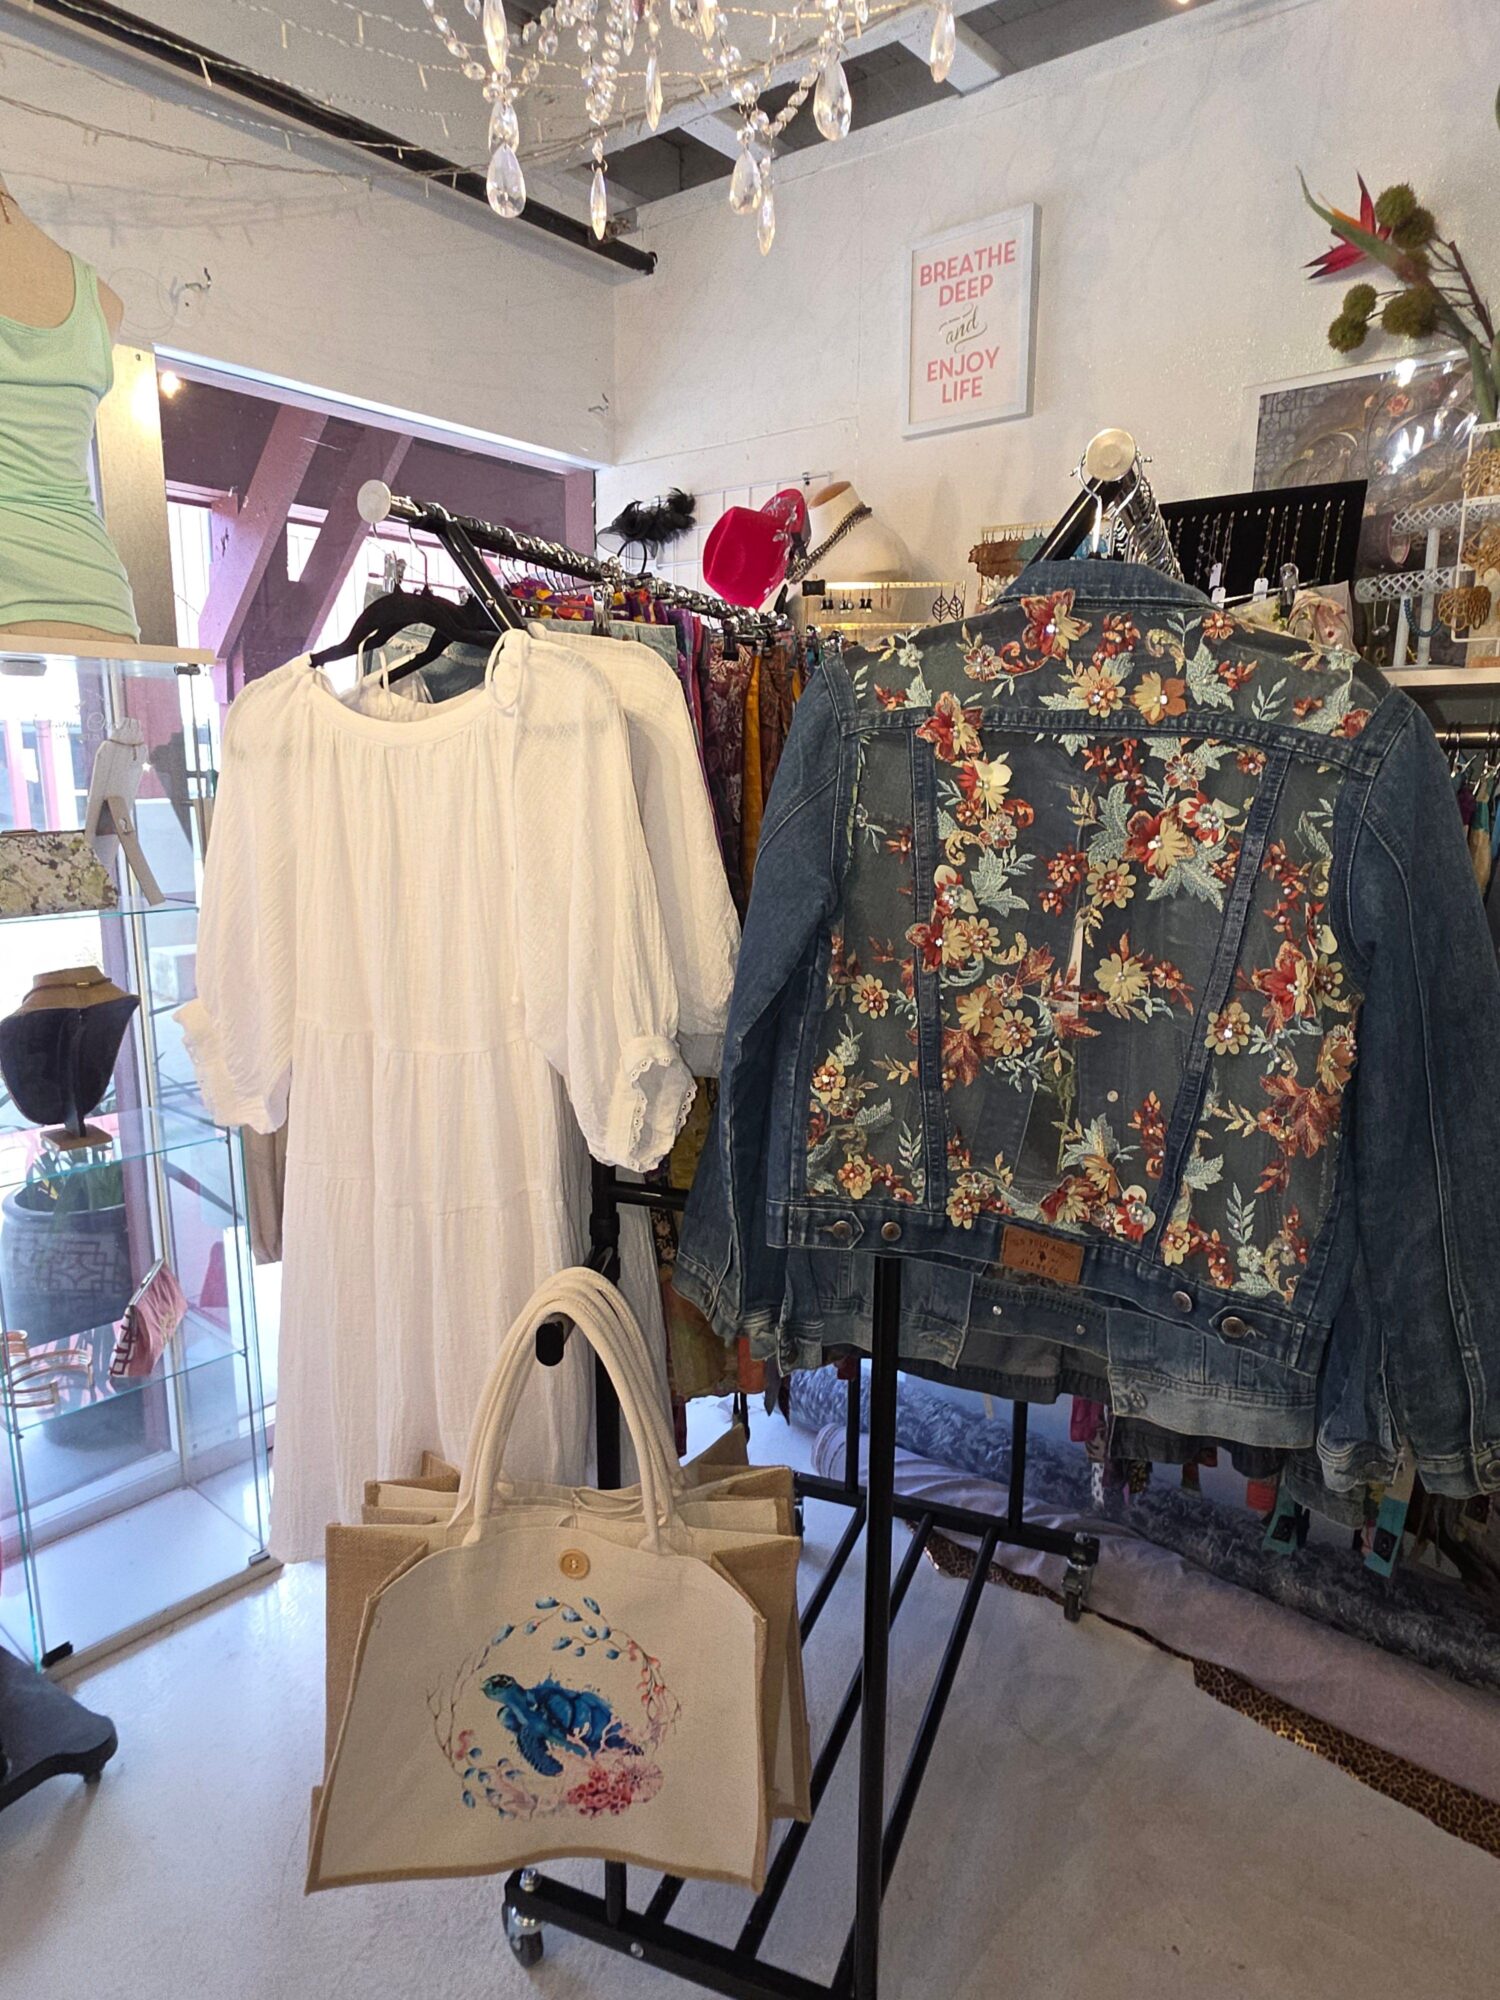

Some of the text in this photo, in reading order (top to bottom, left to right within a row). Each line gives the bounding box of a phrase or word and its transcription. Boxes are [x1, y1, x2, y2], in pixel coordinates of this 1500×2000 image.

[919, 239, 1017, 287] BREATHE
[938, 274, 994, 308] DEEP
[943, 304, 983, 348] and
[926, 346, 1001, 382] ENJOY
[941, 376, 984, 404] LIFE
